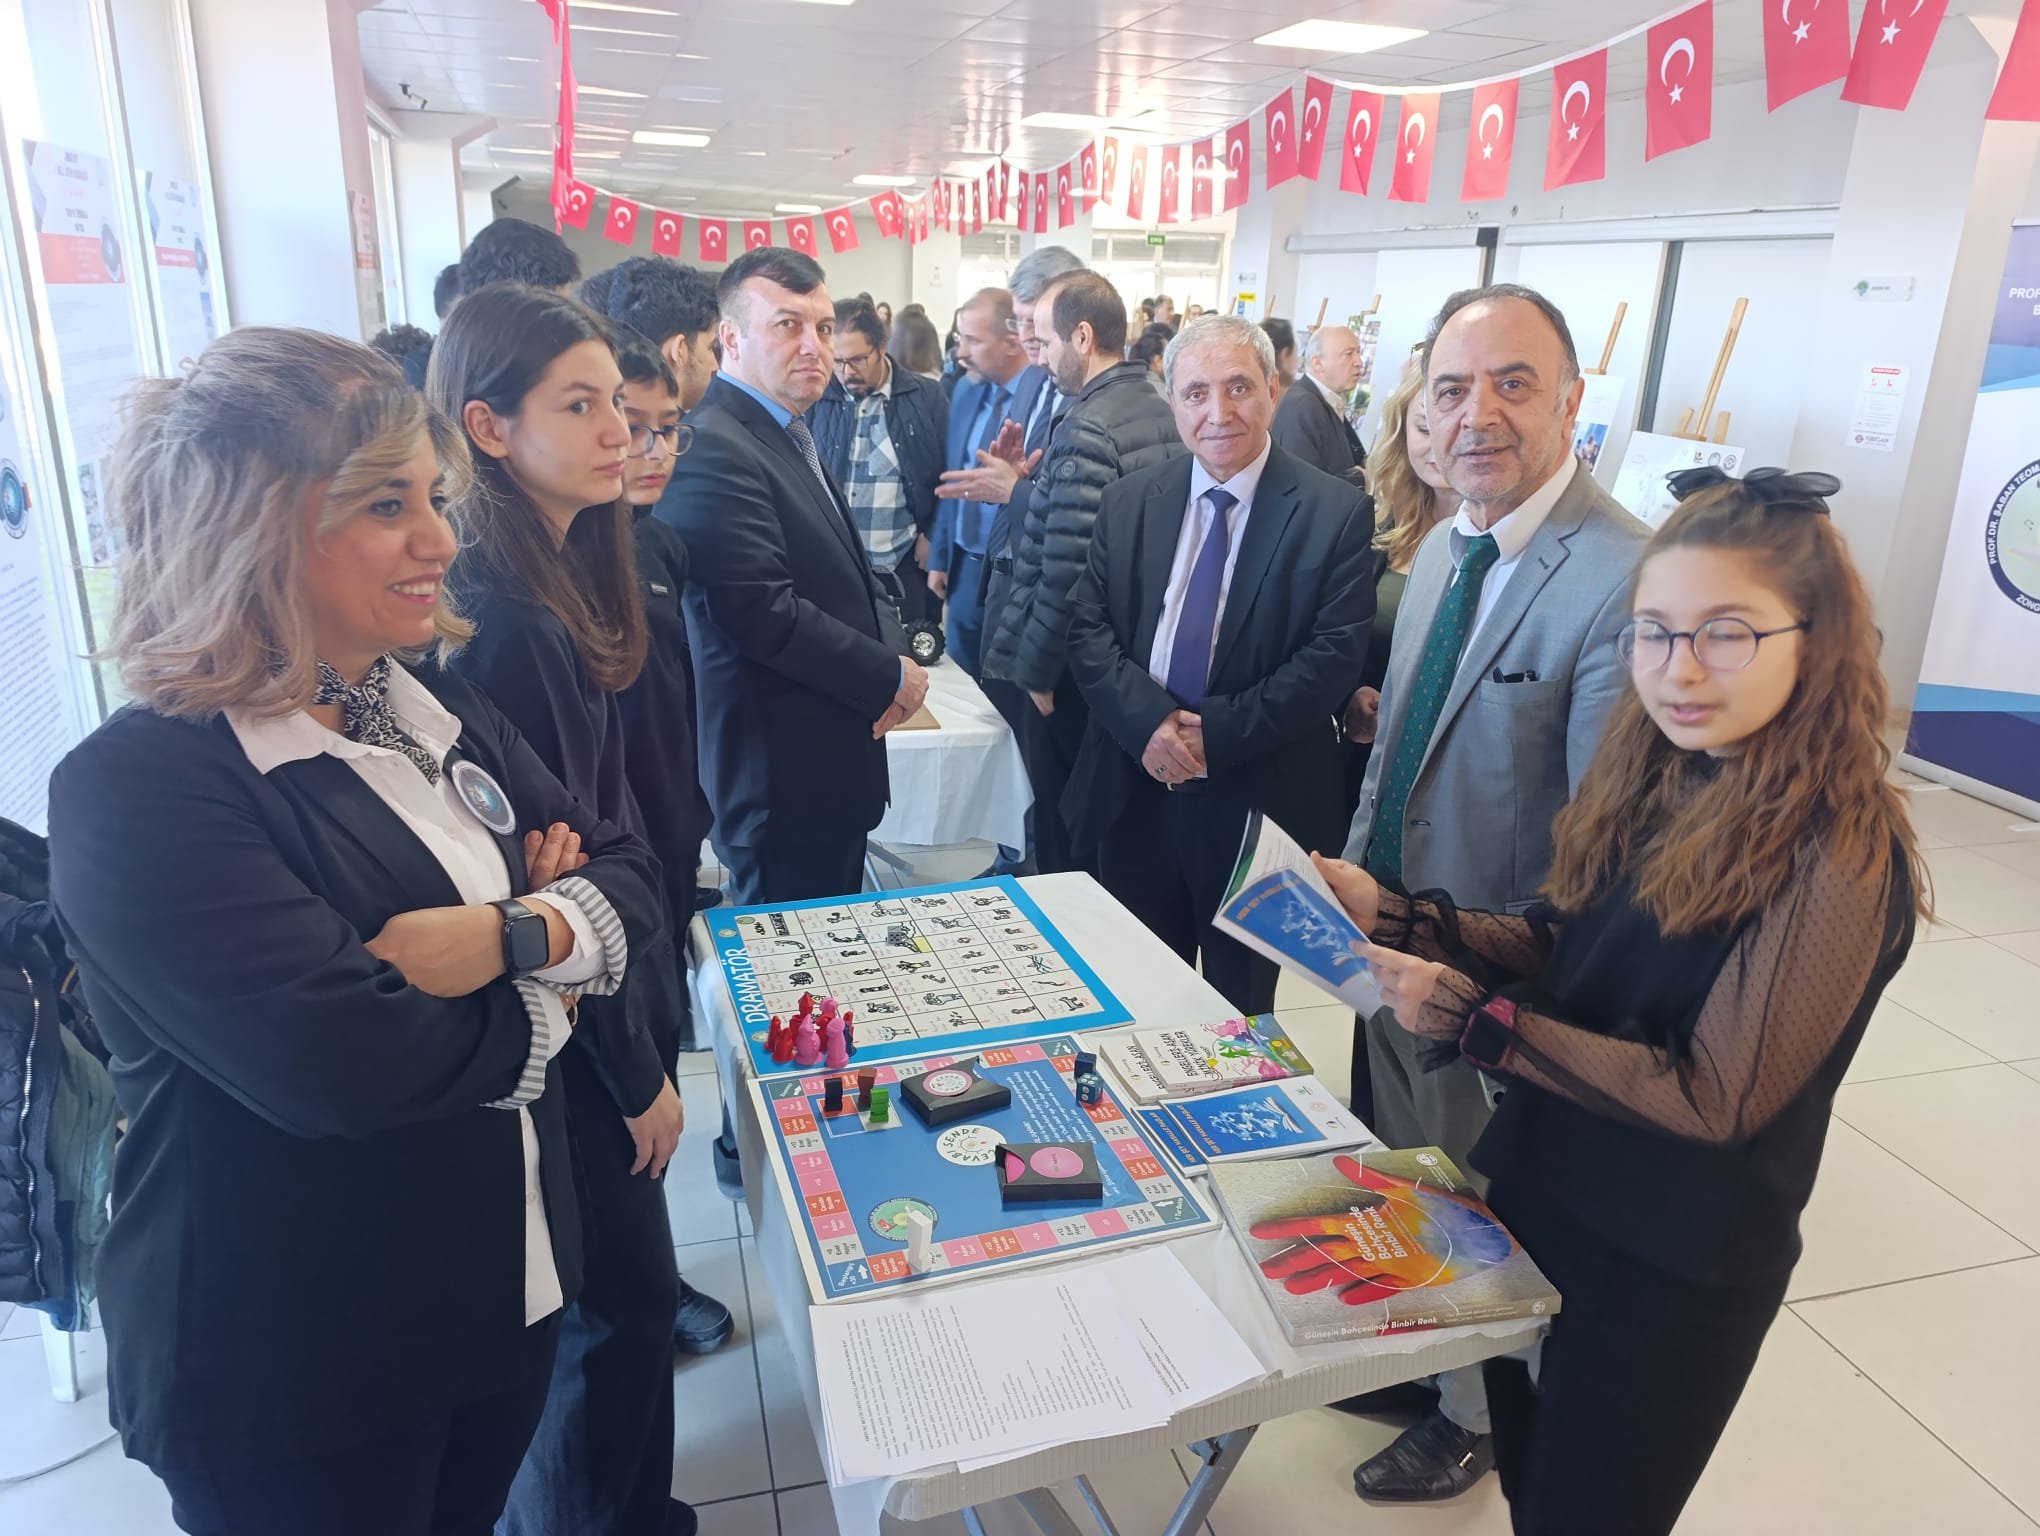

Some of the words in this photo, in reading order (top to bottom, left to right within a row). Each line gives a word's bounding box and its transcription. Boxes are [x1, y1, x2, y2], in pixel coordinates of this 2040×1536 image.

[719, 947, 770, 1024] DRAMATÖR
[943, 1128, 980, 1147] SENDE
[1363, 1205, 1388, 1229] Renk
[1344, 1222, 1376, 1261] Güneşin
[1349, 1206, 1393, 1260] Bahçesinde
[1381, 1229, 1409, 1258] Binbir
[1304, 1328, 1339, 1340] Güneşin
[1341, 1322, 1390, 1335] Bahçesinde
[1391, 1319, 1416, 1329] Binbir
[1417, 1315, 1438, 1326] Renk
